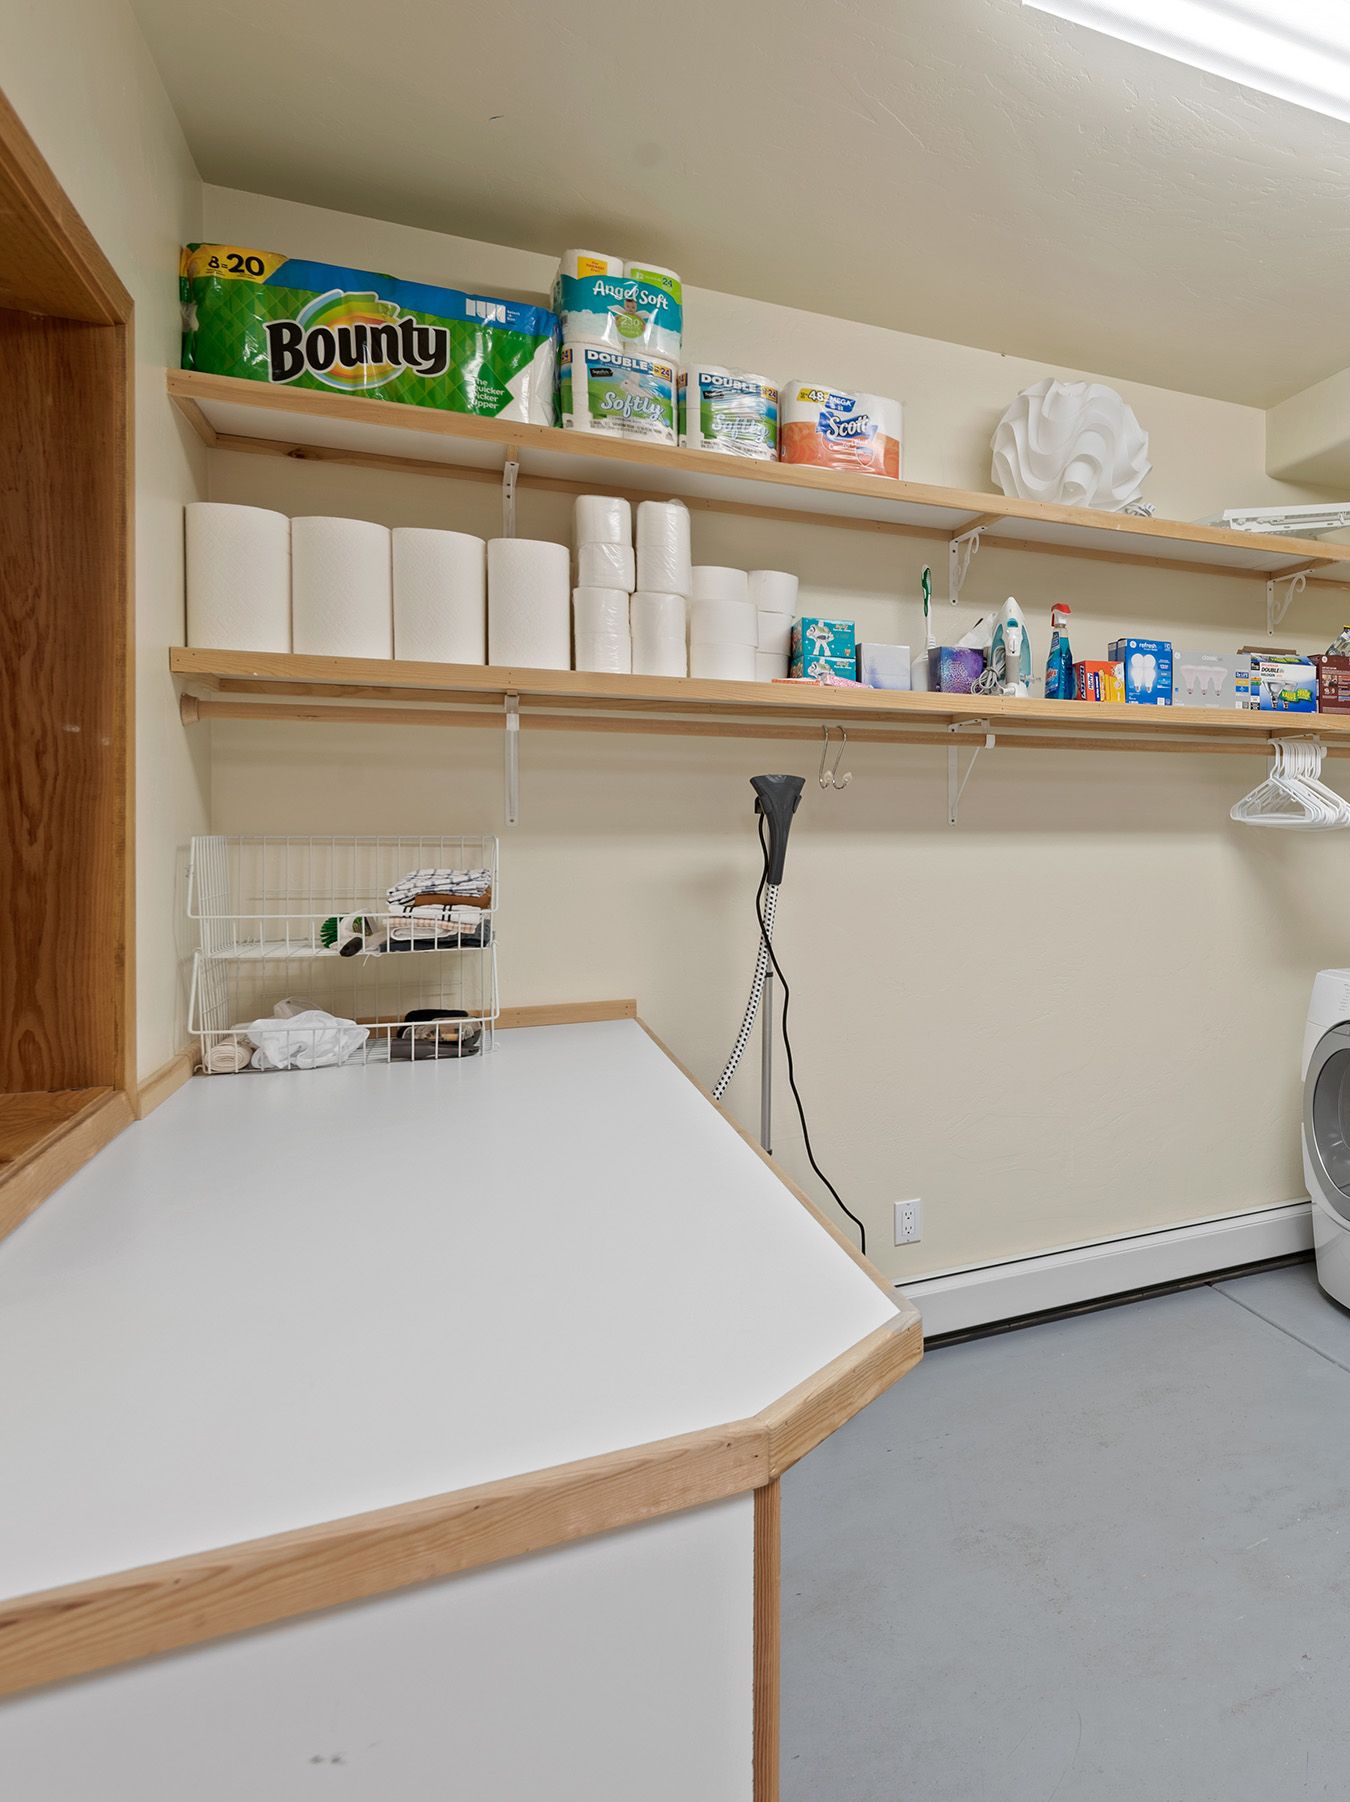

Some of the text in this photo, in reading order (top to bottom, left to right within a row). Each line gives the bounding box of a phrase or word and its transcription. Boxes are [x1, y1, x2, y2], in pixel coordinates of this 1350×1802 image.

[662, 277, 673, 288] 24
[593, 280, 669, 310] Angel Soft
[265, 318, 447, 382] Bounty
[587, 350, 648, 371] DOUBLE
[701, 374, 757, 393] DOUBLE
[808, 389, 825, 402] 48
[601, 391, 665, 420] Softly
[711, 413, 769, 444] Softly
[827, 415, 869, 439] Scott
